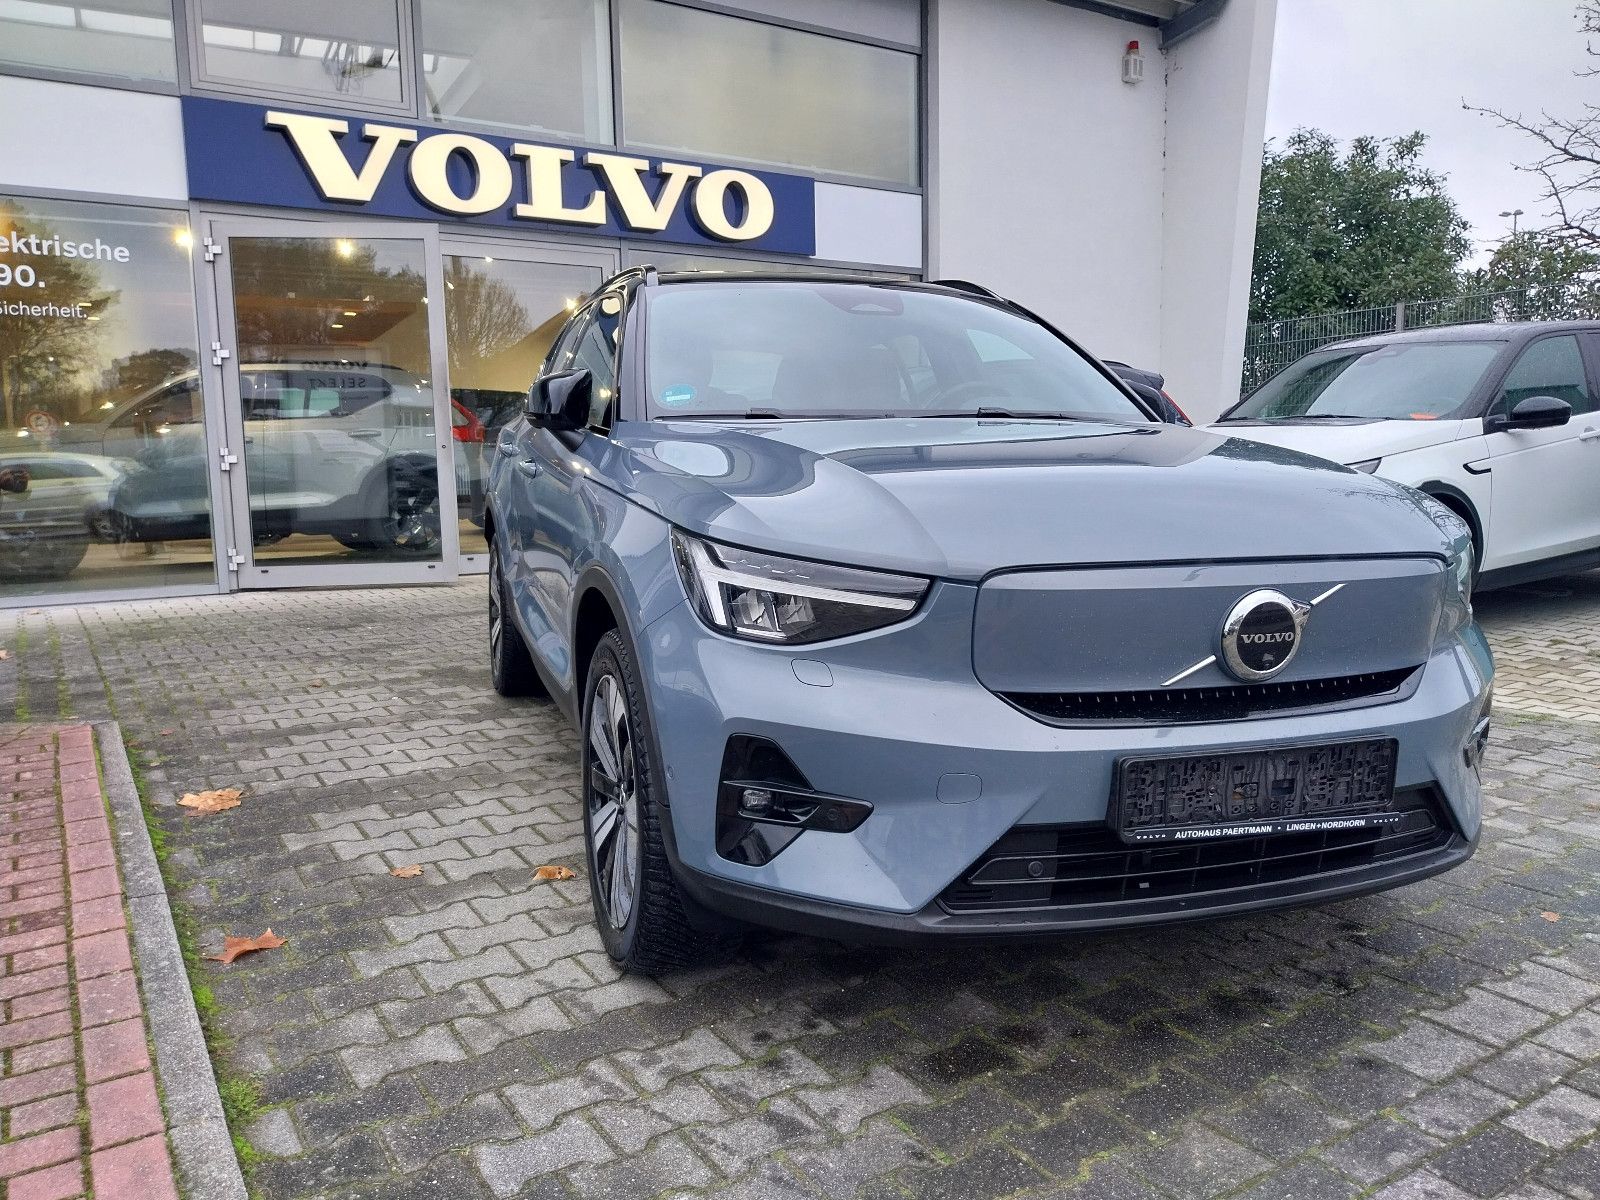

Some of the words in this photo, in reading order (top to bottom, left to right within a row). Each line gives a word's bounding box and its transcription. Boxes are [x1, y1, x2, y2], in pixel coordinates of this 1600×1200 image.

[264, 110, 775, 242] VOLVO
[0, 300, 87, 318] icherheit.
[1241, 631, 1294, 643] VOLVO
[1175, 828, 1221, 839] AUTOHAUS
[1222, 825, 1273, 836] PAERTMANN
[1286, 819, 1366, 831] LINGEN+NORDHORN
